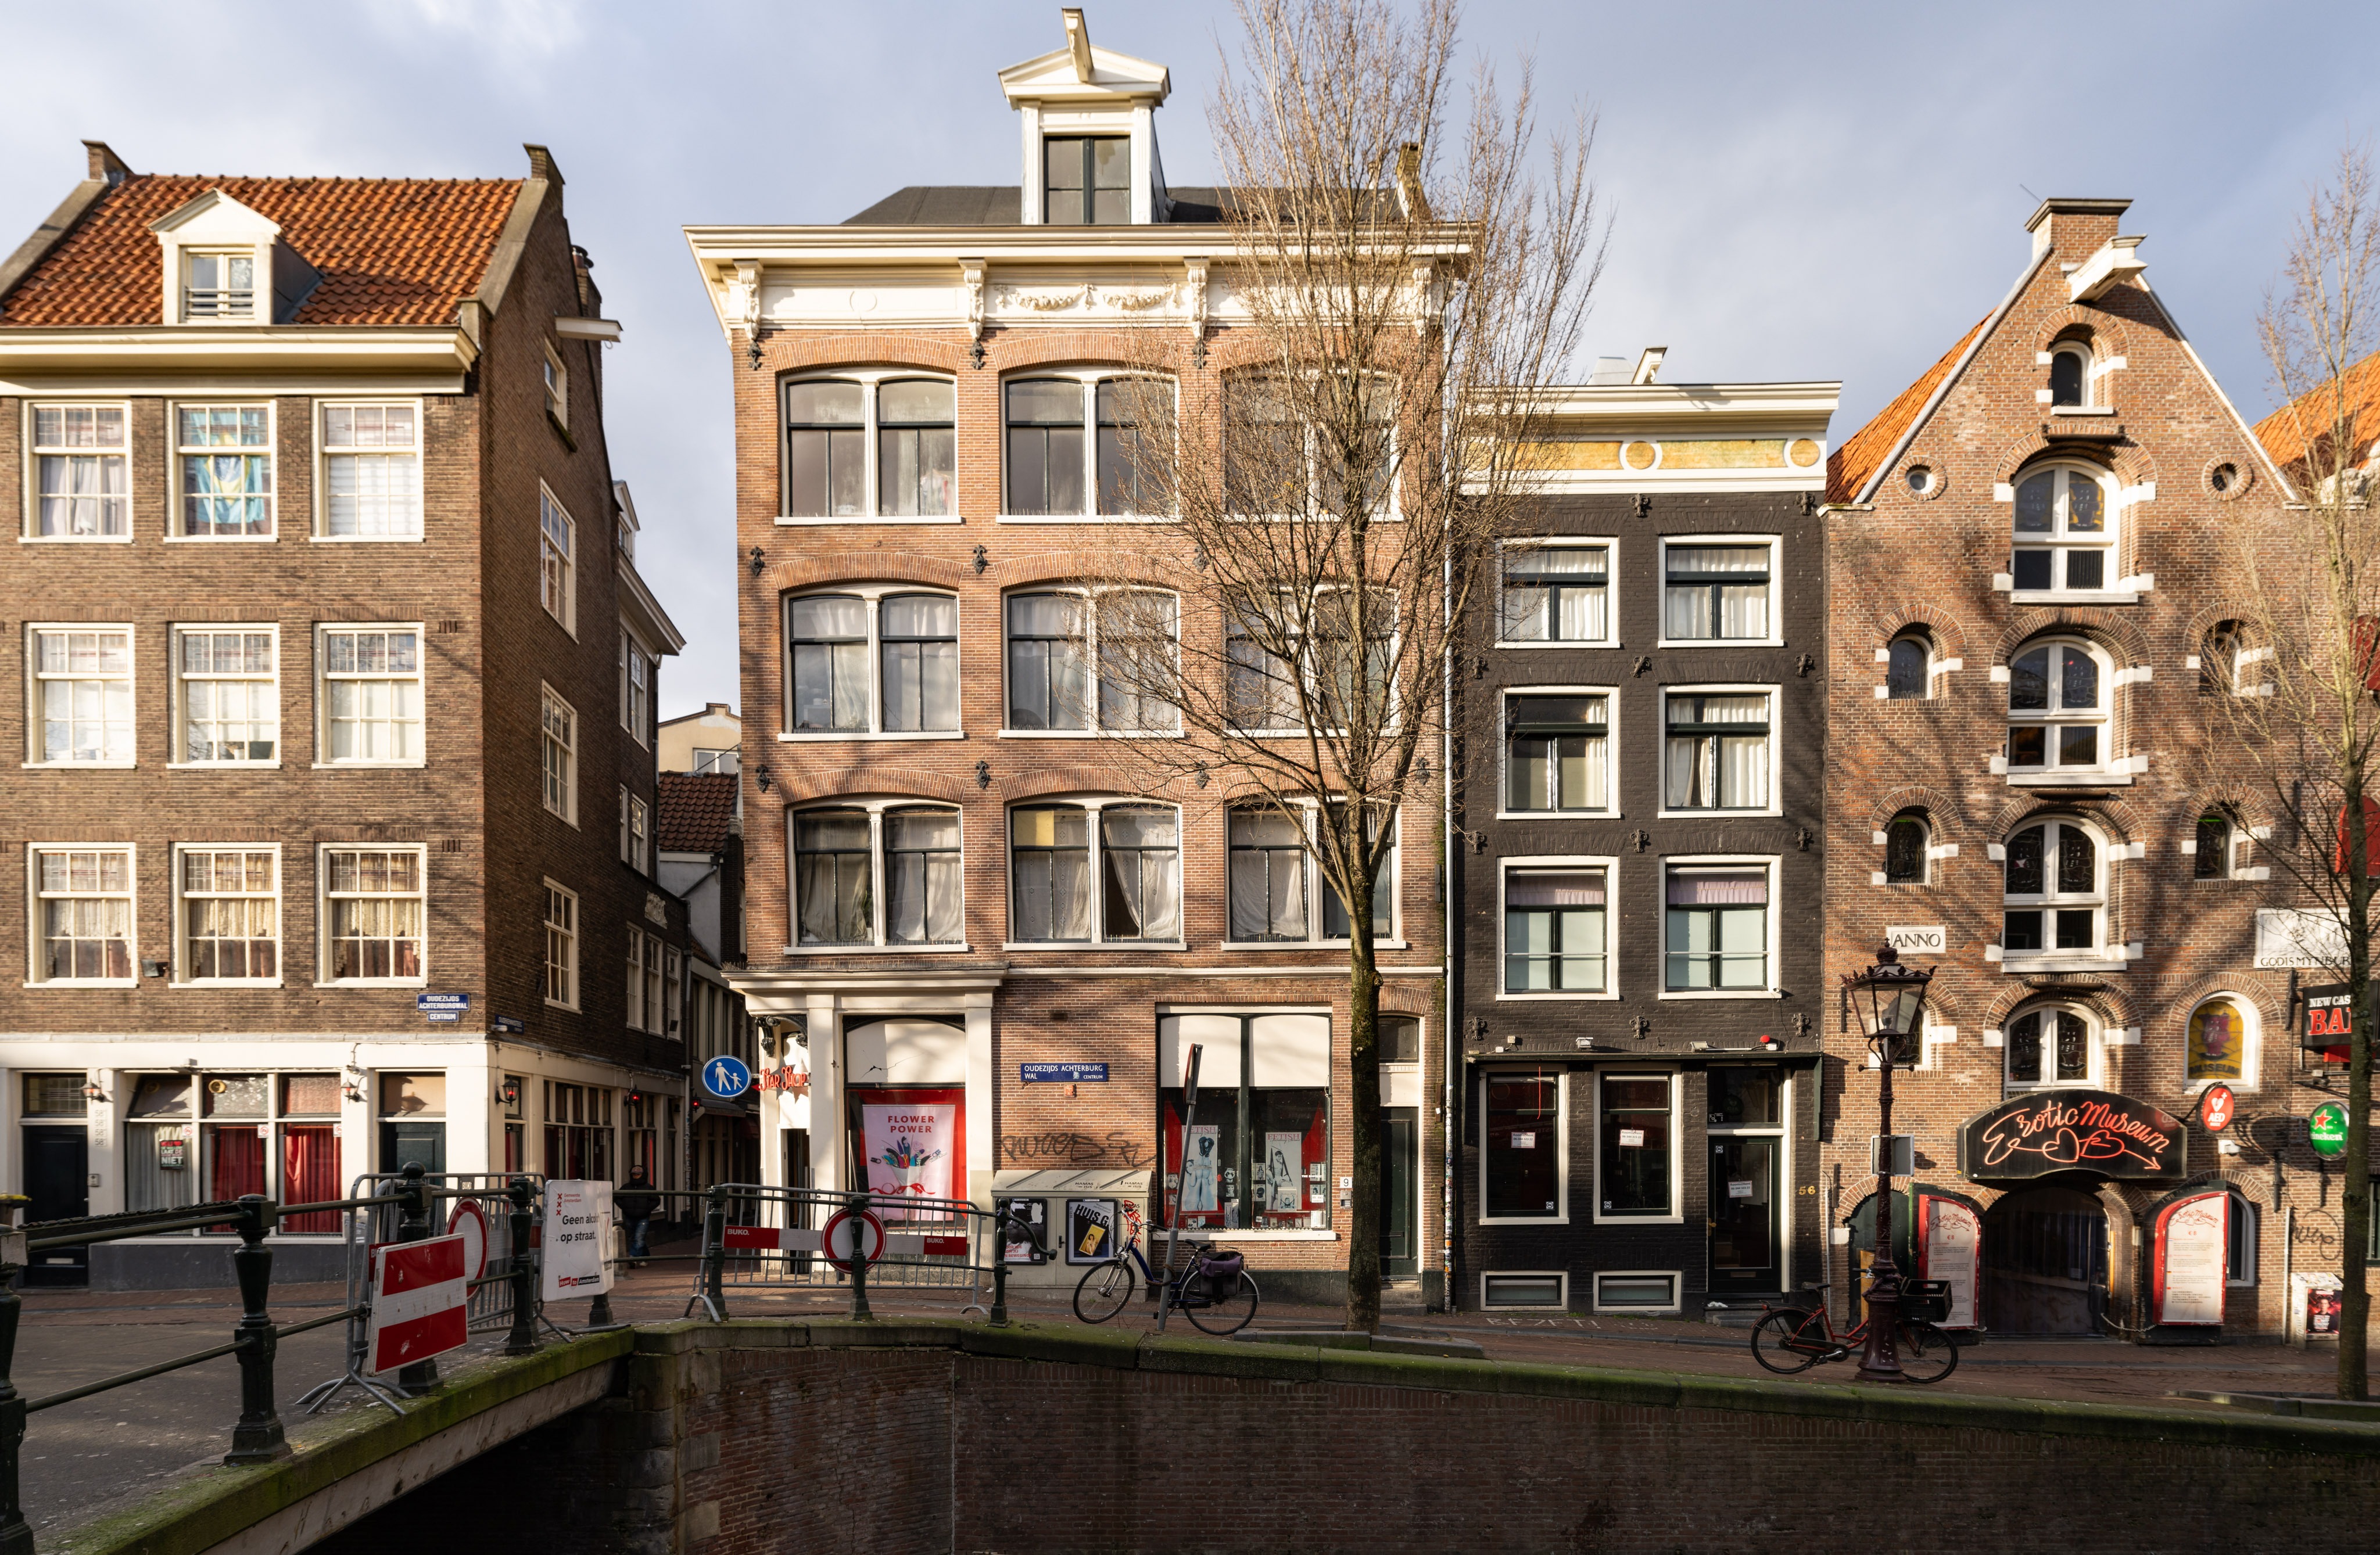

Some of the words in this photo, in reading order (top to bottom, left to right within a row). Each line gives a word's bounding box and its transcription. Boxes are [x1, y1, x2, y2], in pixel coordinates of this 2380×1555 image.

[1892, 933, 1941, 947] ANNO
[2309, 997, 2332, 1008] NEW
[2332, 995, 2351, 1005] CAS
[2189, 1062, 2240, 1075] MUSEUM
[2207, 1112, 2225, 1122] AED
[1983, 1100, 2078, 1165] Erotic
[2080, 1101, 2170, 1153] Museum
[2310, 1132, 2343, 1141] eineken
[1343, 1178, 1349, 1187] 9
[1798, 1186, 1816, 1195] 56
[562, 1215, 584, 1224] Geen
[1074, 1204, 1101, 1223] HUIS
[561, 1233, 572, 1244] op
[575, 1231, 596, 1241] straat.
